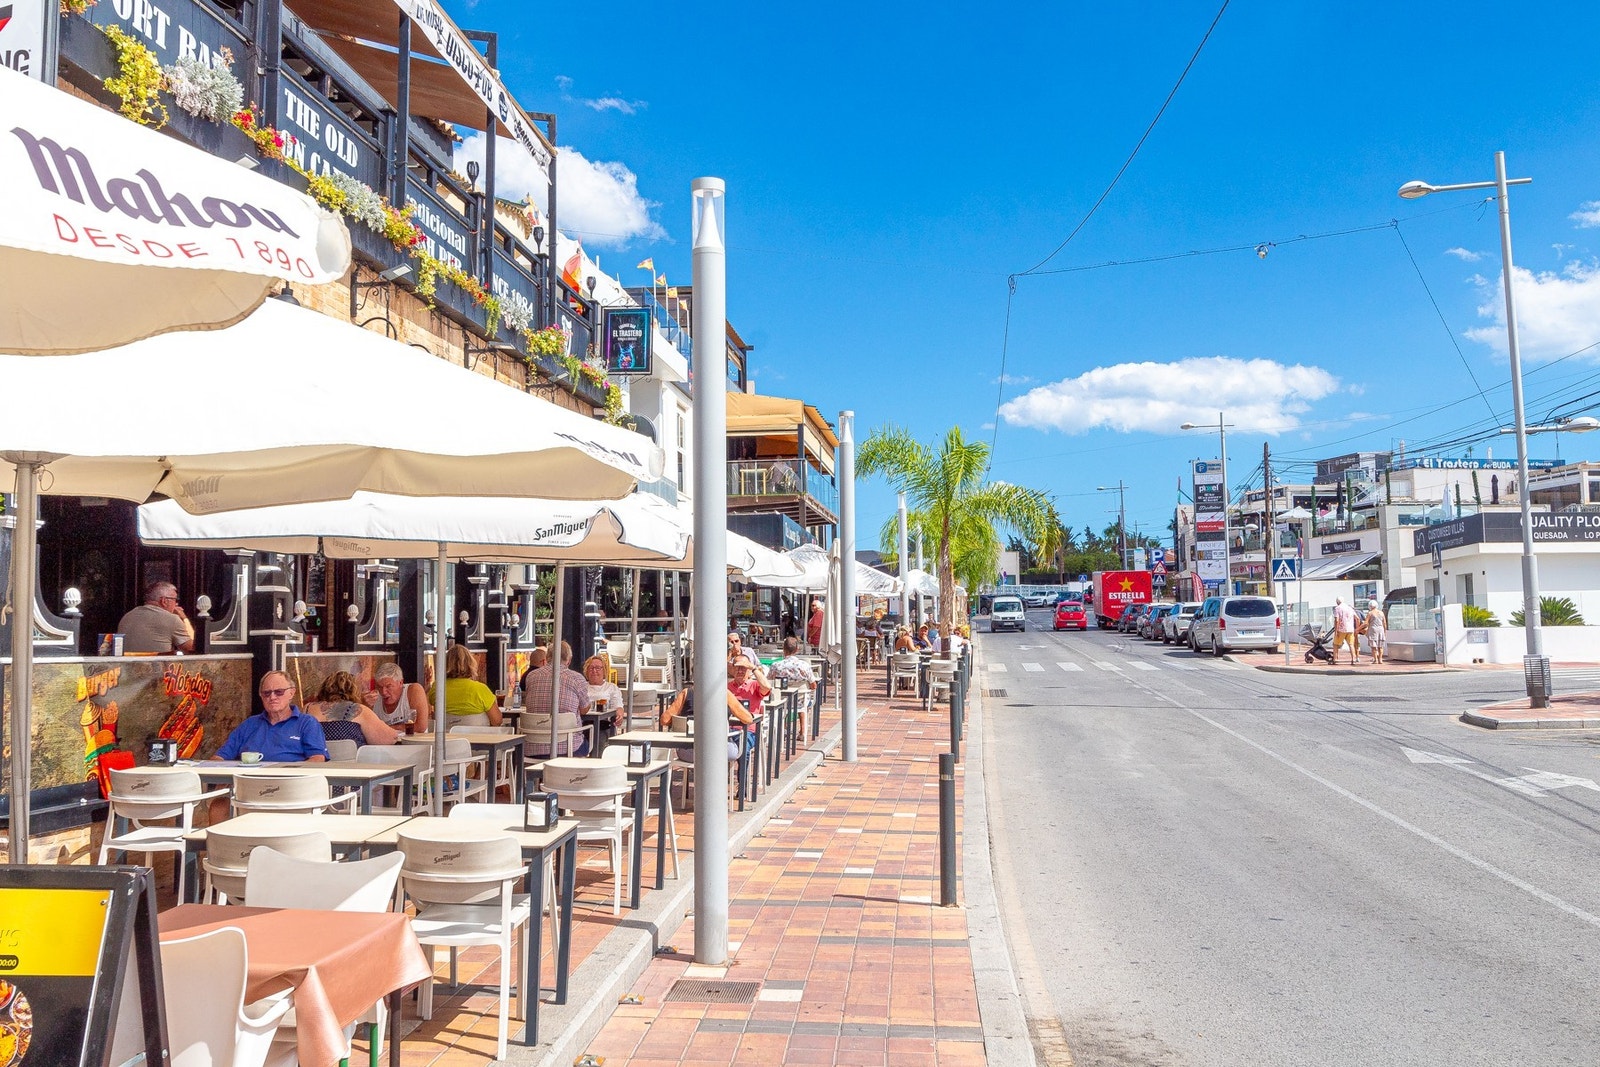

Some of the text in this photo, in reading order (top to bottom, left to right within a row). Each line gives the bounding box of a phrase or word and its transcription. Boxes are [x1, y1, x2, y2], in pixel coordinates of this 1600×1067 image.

[177, 25, 224, 70] BA
[284, 88, 358, 168] THE OLD
[11, 127, 300, 239] Mahou
[53, 213, 314, 278] DESDE 1890
[1423, 459, 1433, 467] El
[1436, 459, 1479, 469] Trastero
[1492, 461, 1511, 469] BUDA
[533, 518, 589, 541] SanMiguel
[1108, 592, 1145, 600] ESTRELLA
